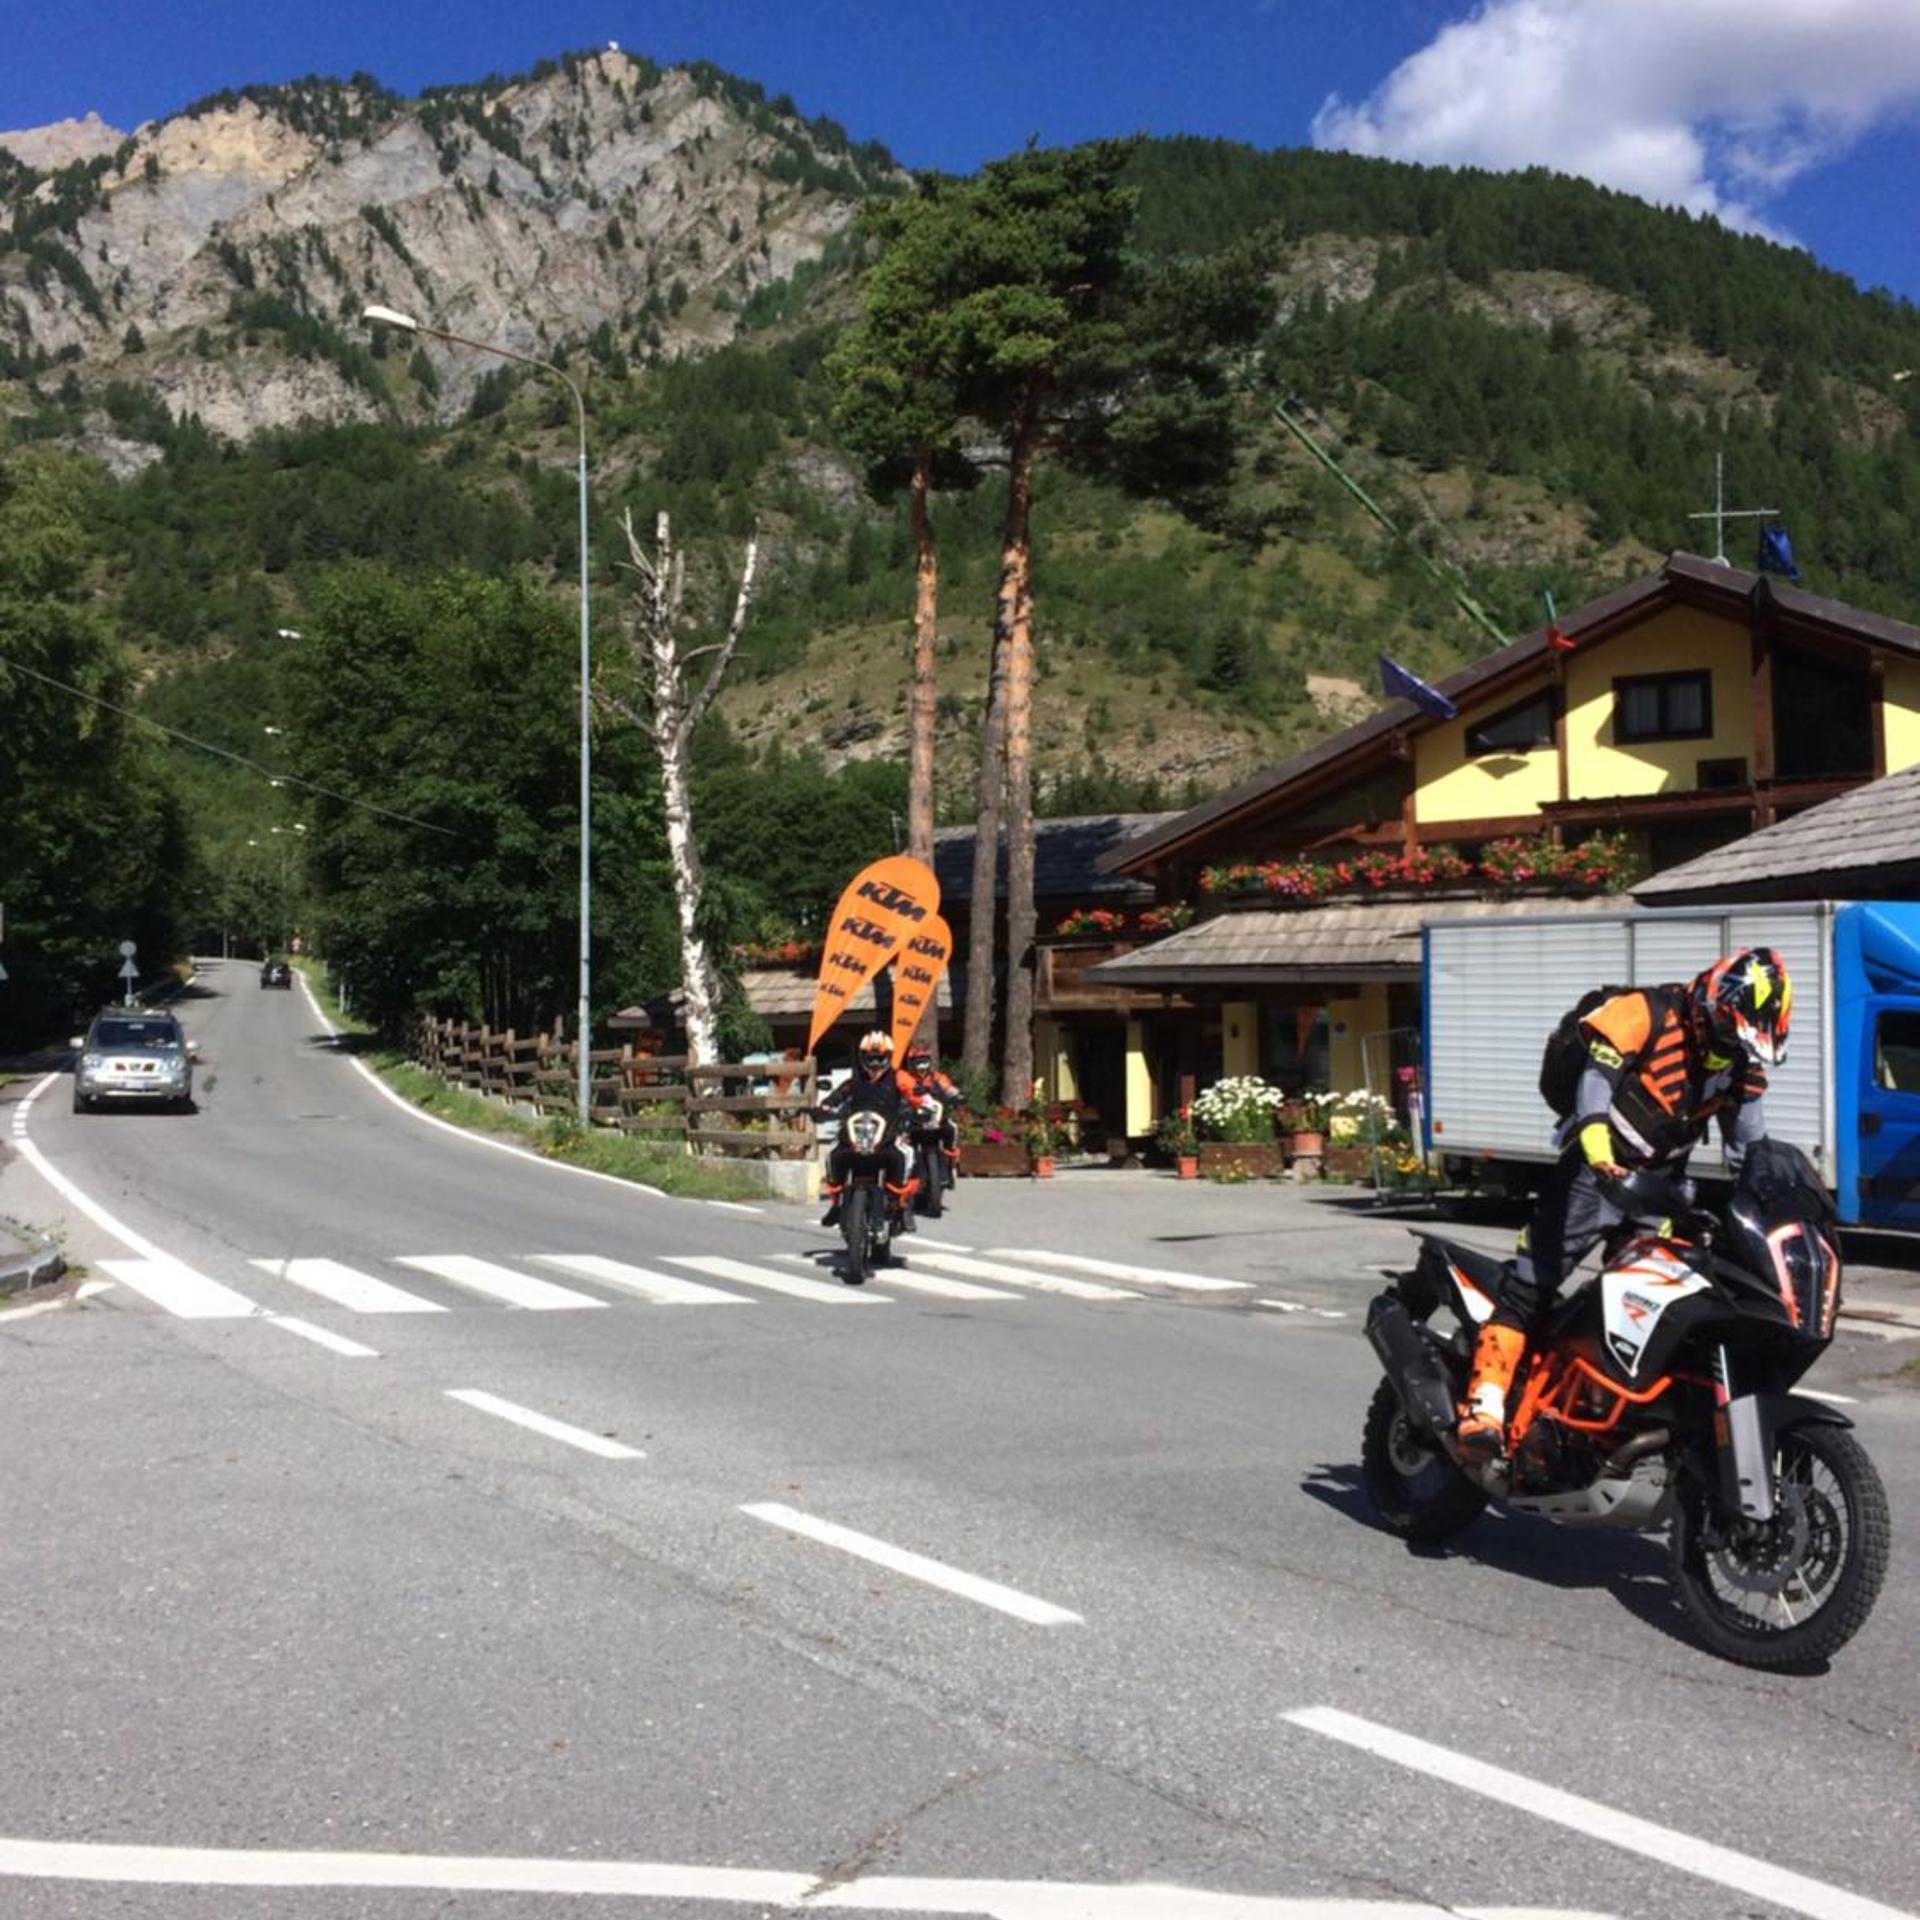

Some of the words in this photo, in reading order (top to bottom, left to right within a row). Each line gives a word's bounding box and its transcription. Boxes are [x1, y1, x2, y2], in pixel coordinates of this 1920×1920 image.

[857, 881, 926, 922] KTM
[841, 915, 896, 949] KTM
[908, 936, 946, 960] KTM
[830, 952, 867, 975] KTM
[903, 965, 932, 985] KTM
